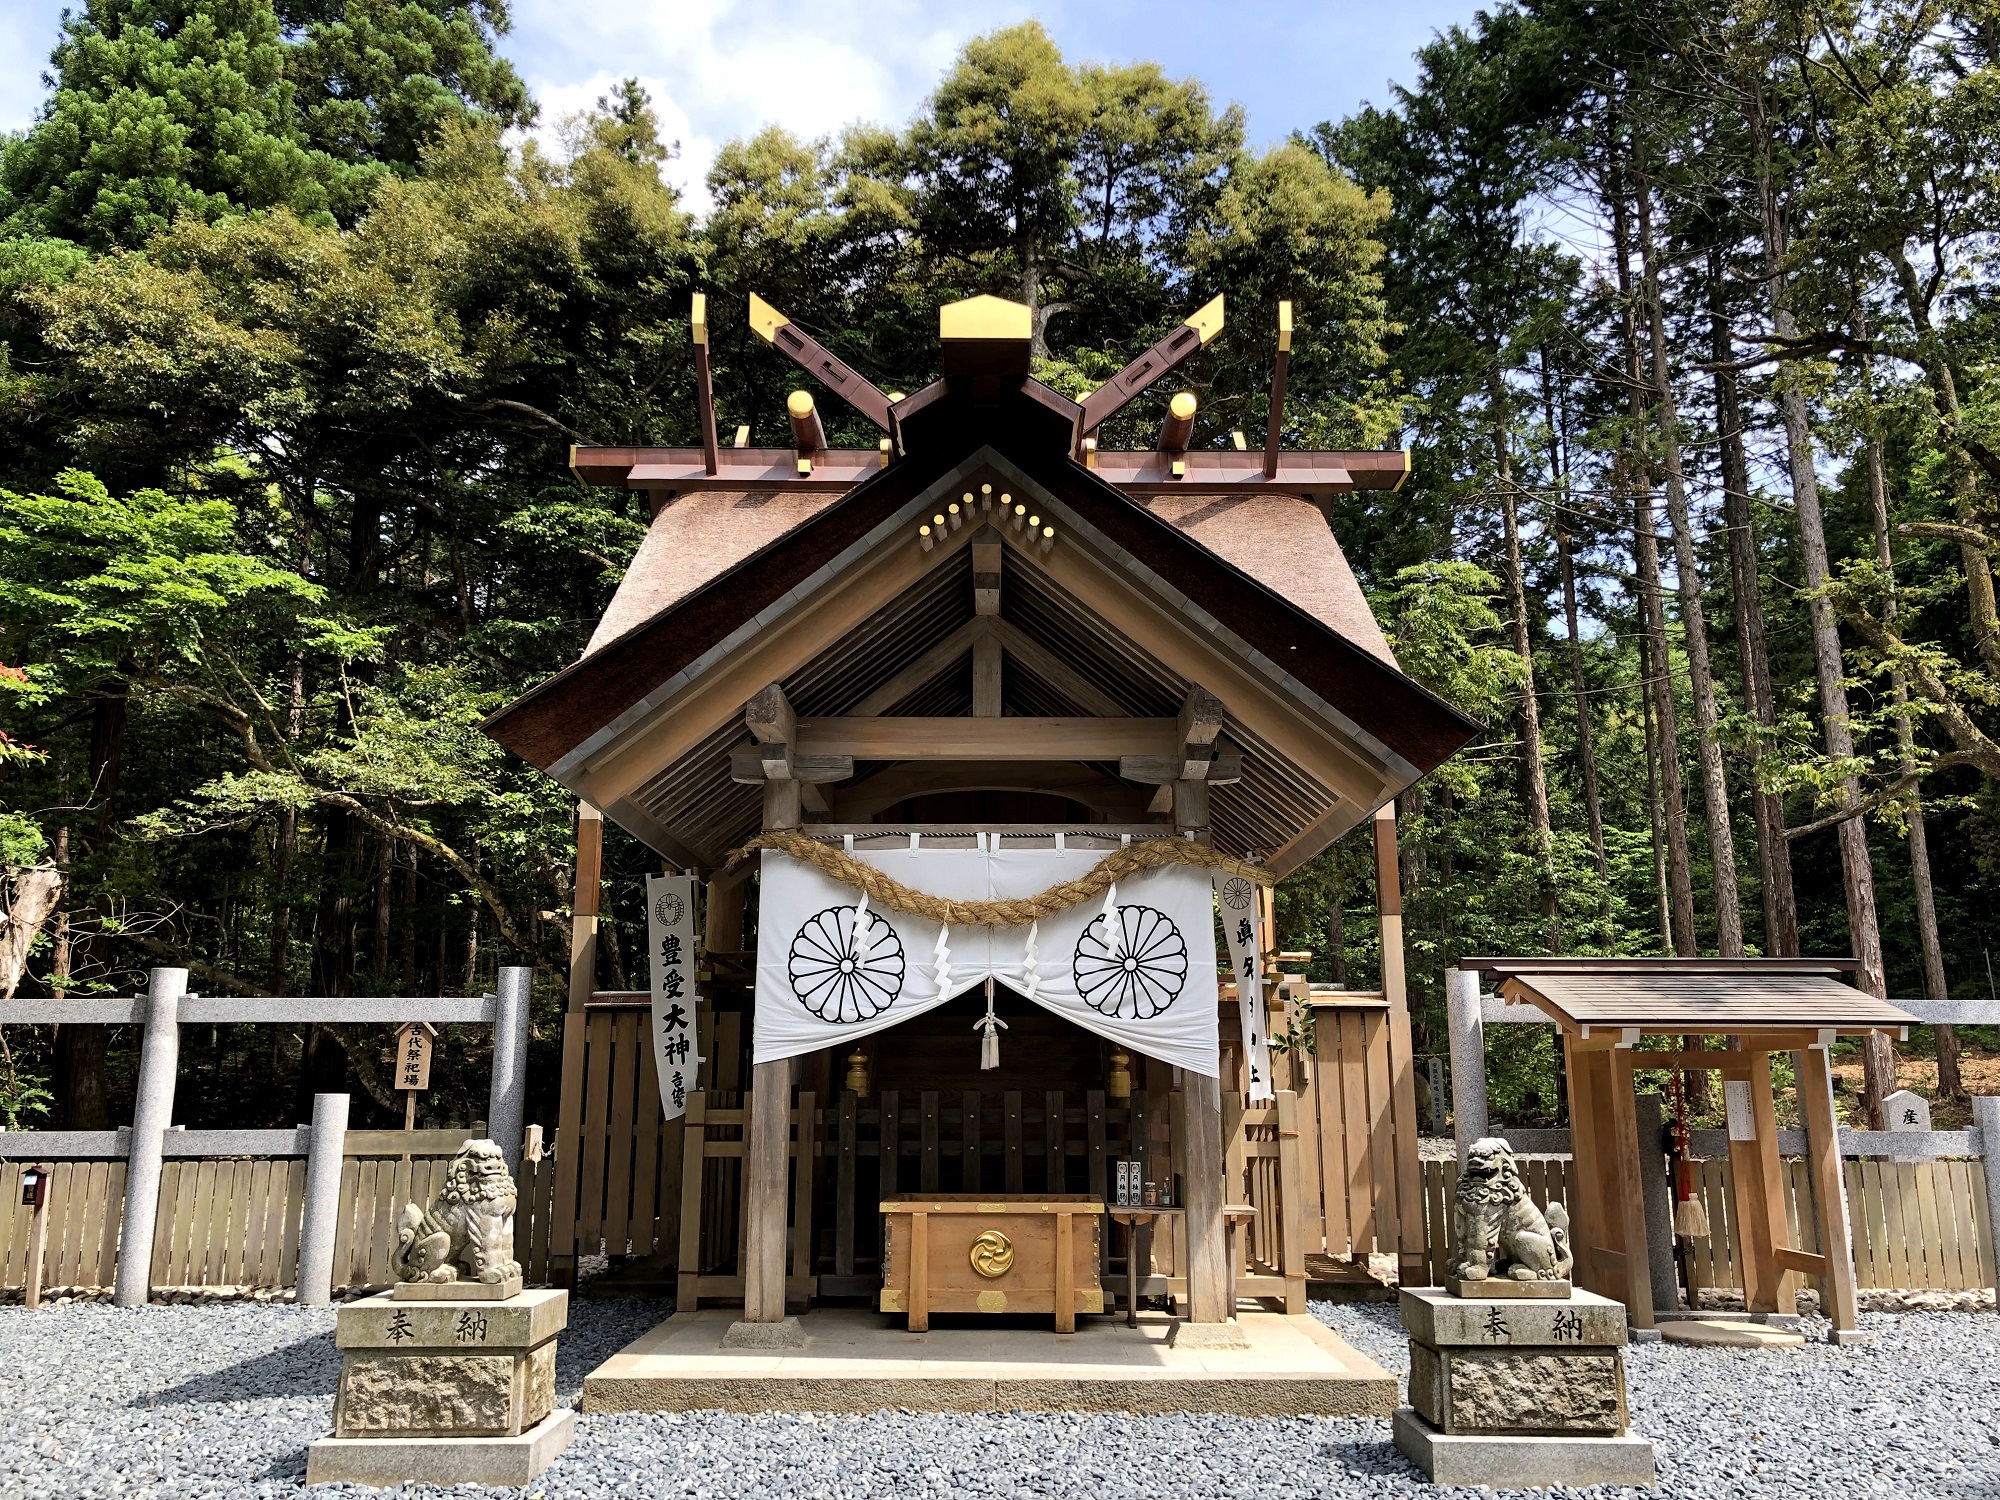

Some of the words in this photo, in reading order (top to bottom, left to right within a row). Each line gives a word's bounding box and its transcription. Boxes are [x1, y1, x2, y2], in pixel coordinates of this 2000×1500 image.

[660, 933, 690, 1066] 豊受大神
[403, 1024, 424, 1087] 古代祭祀場
[1902, 1107, 1919, 1125] 産
